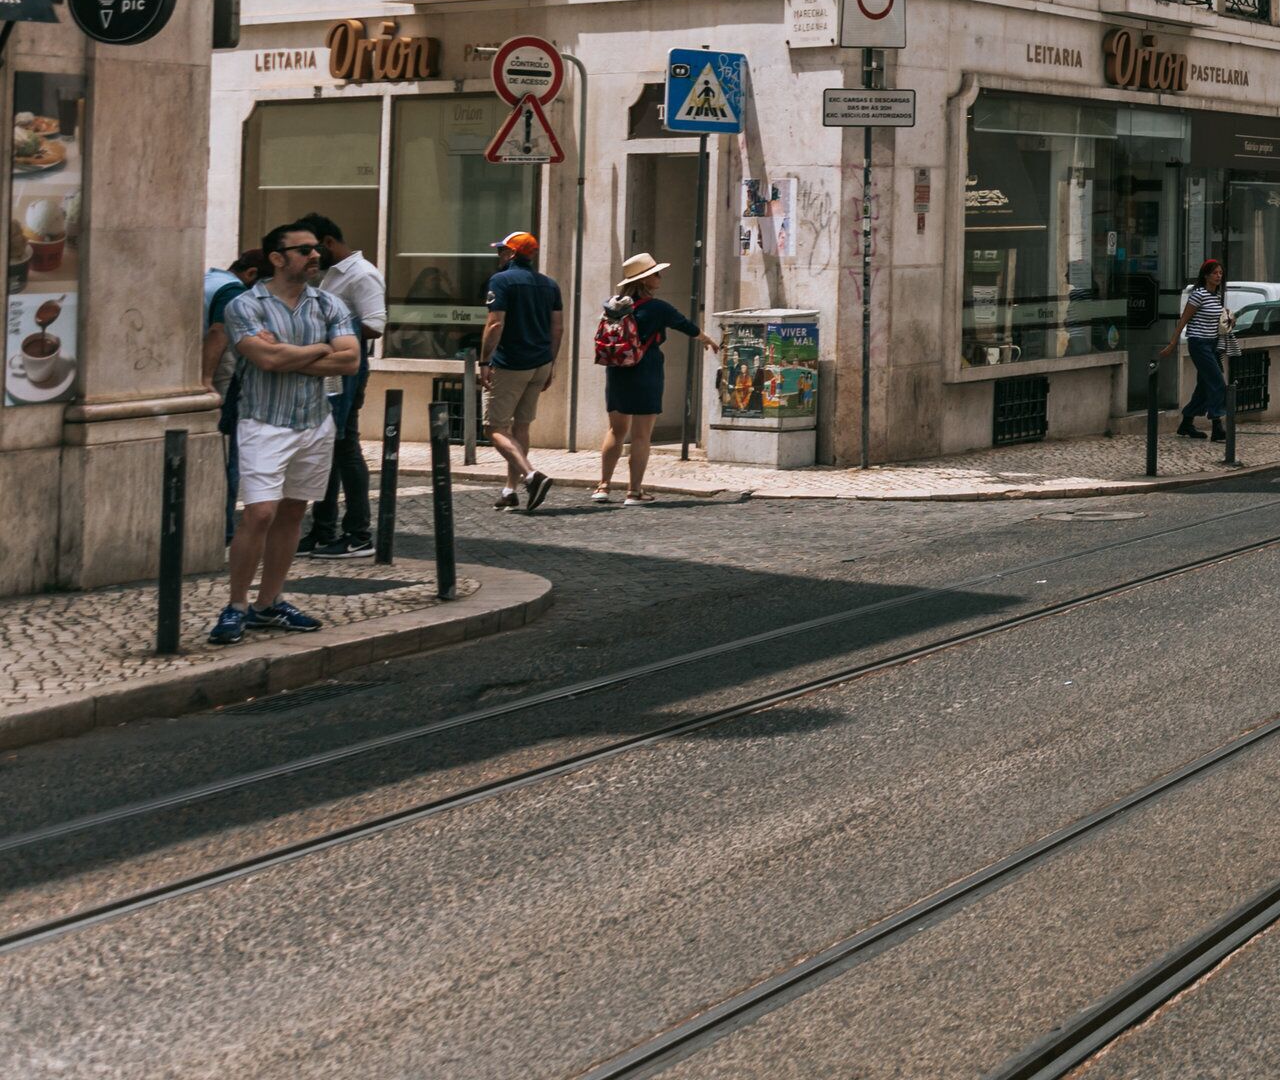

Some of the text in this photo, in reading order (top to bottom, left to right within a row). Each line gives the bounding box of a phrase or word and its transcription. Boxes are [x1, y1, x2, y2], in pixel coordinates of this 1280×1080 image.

[121, 0, 146, 14] pic
[793, 9, 828, 18] MARECHAL
[793, 23, 828, 32] SALDANHA
[255, 51, 317, 72] LEITARIA
[326, 19, 434, 81] Orion
[1026, 29, 1250, 91] LEITARIA Orion PASTELARIA
[510, 61, 550, 69] CONTROLO
[520, 78, 549, 86] ACESSO
[738, 328, 755, 338] MAL
[781, 327, 807, 337] VIVER
[793, 337, 814, 346] MAL
